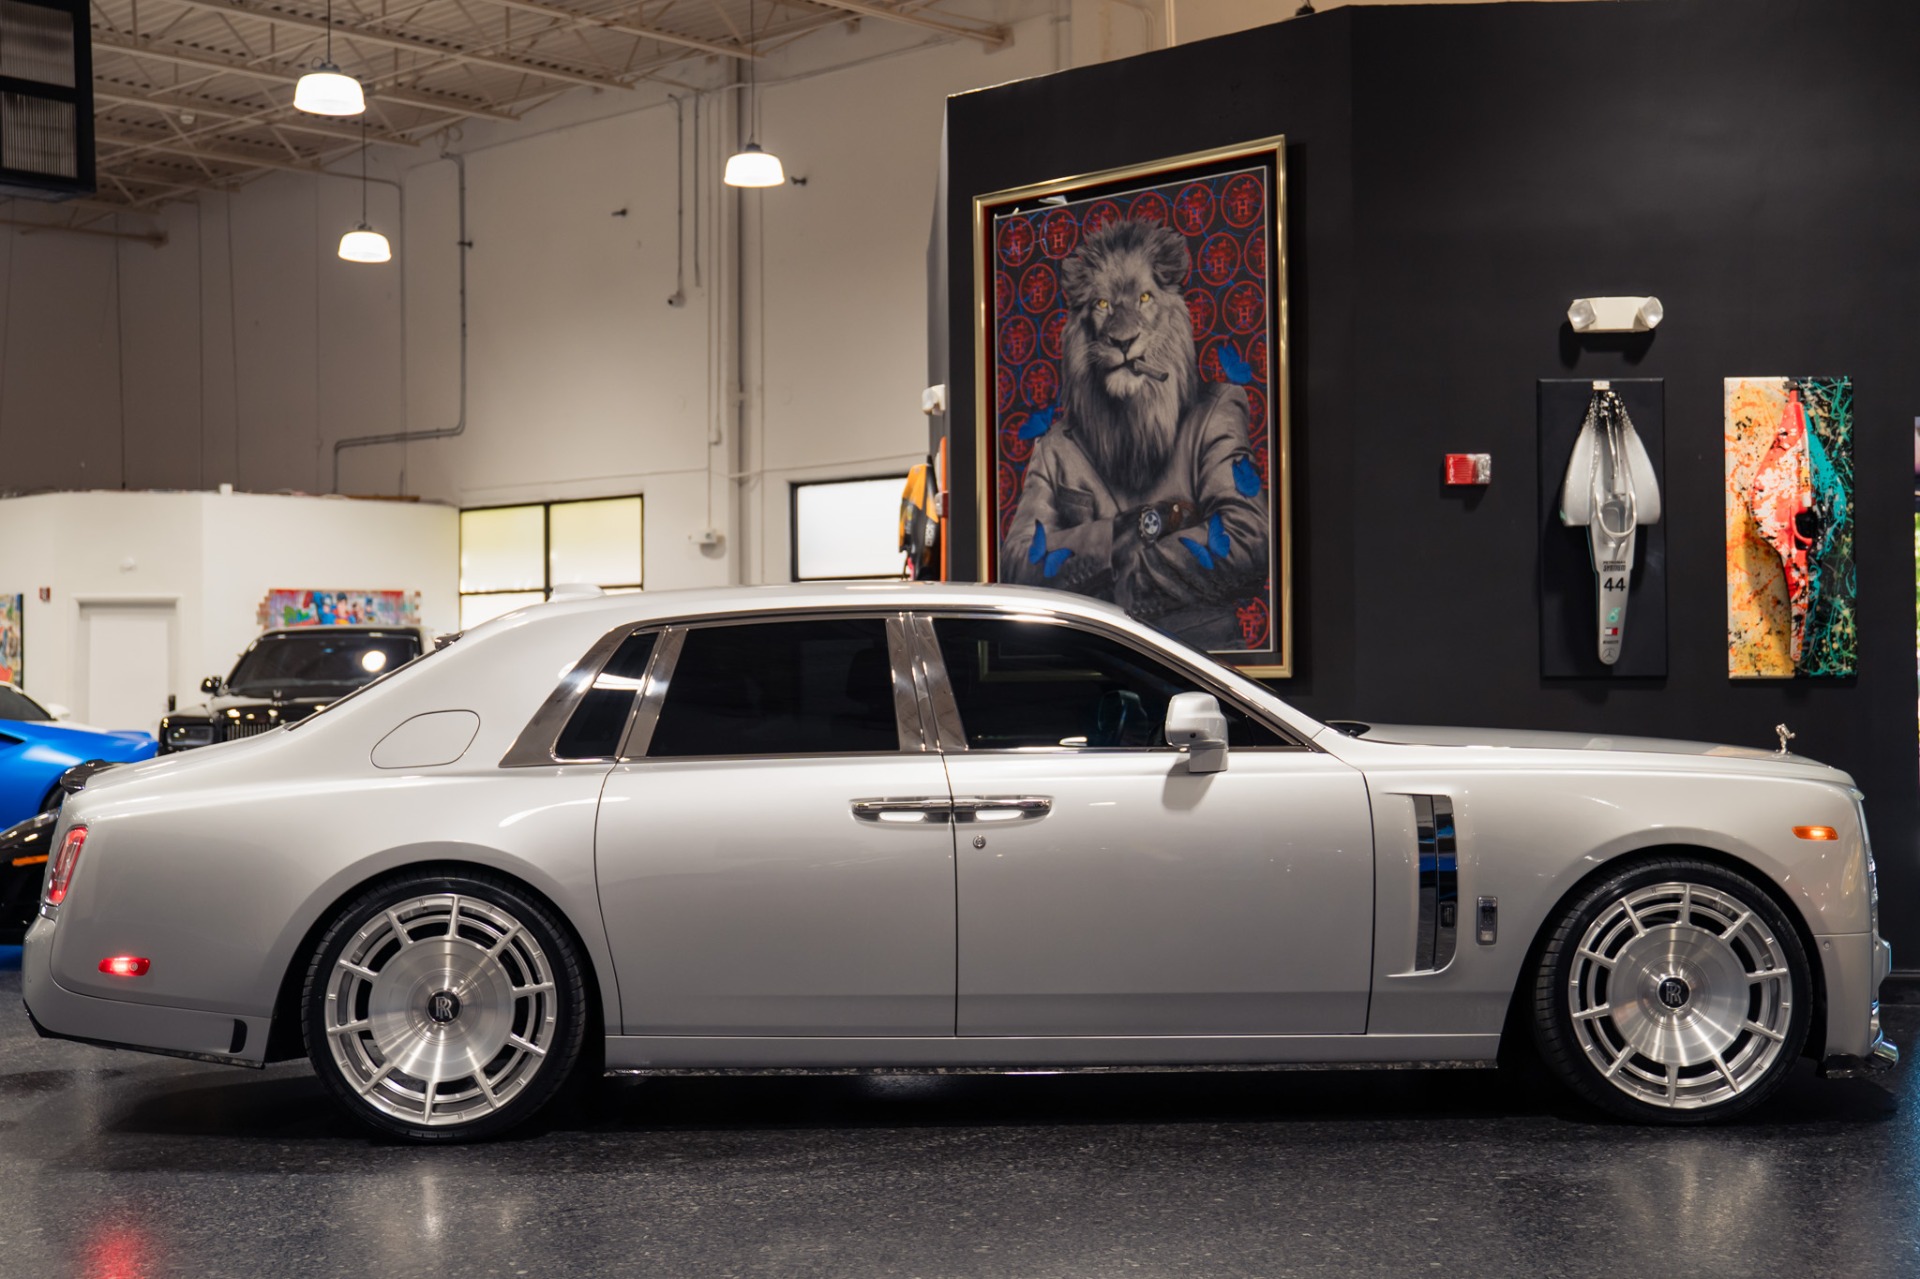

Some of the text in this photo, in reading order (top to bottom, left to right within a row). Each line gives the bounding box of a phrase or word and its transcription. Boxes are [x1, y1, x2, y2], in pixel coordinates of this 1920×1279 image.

[1603, 577, 1626, 592] 44
[1664, 981, 1683, 1004] RR
[435, 996, 453, 1019] RR
